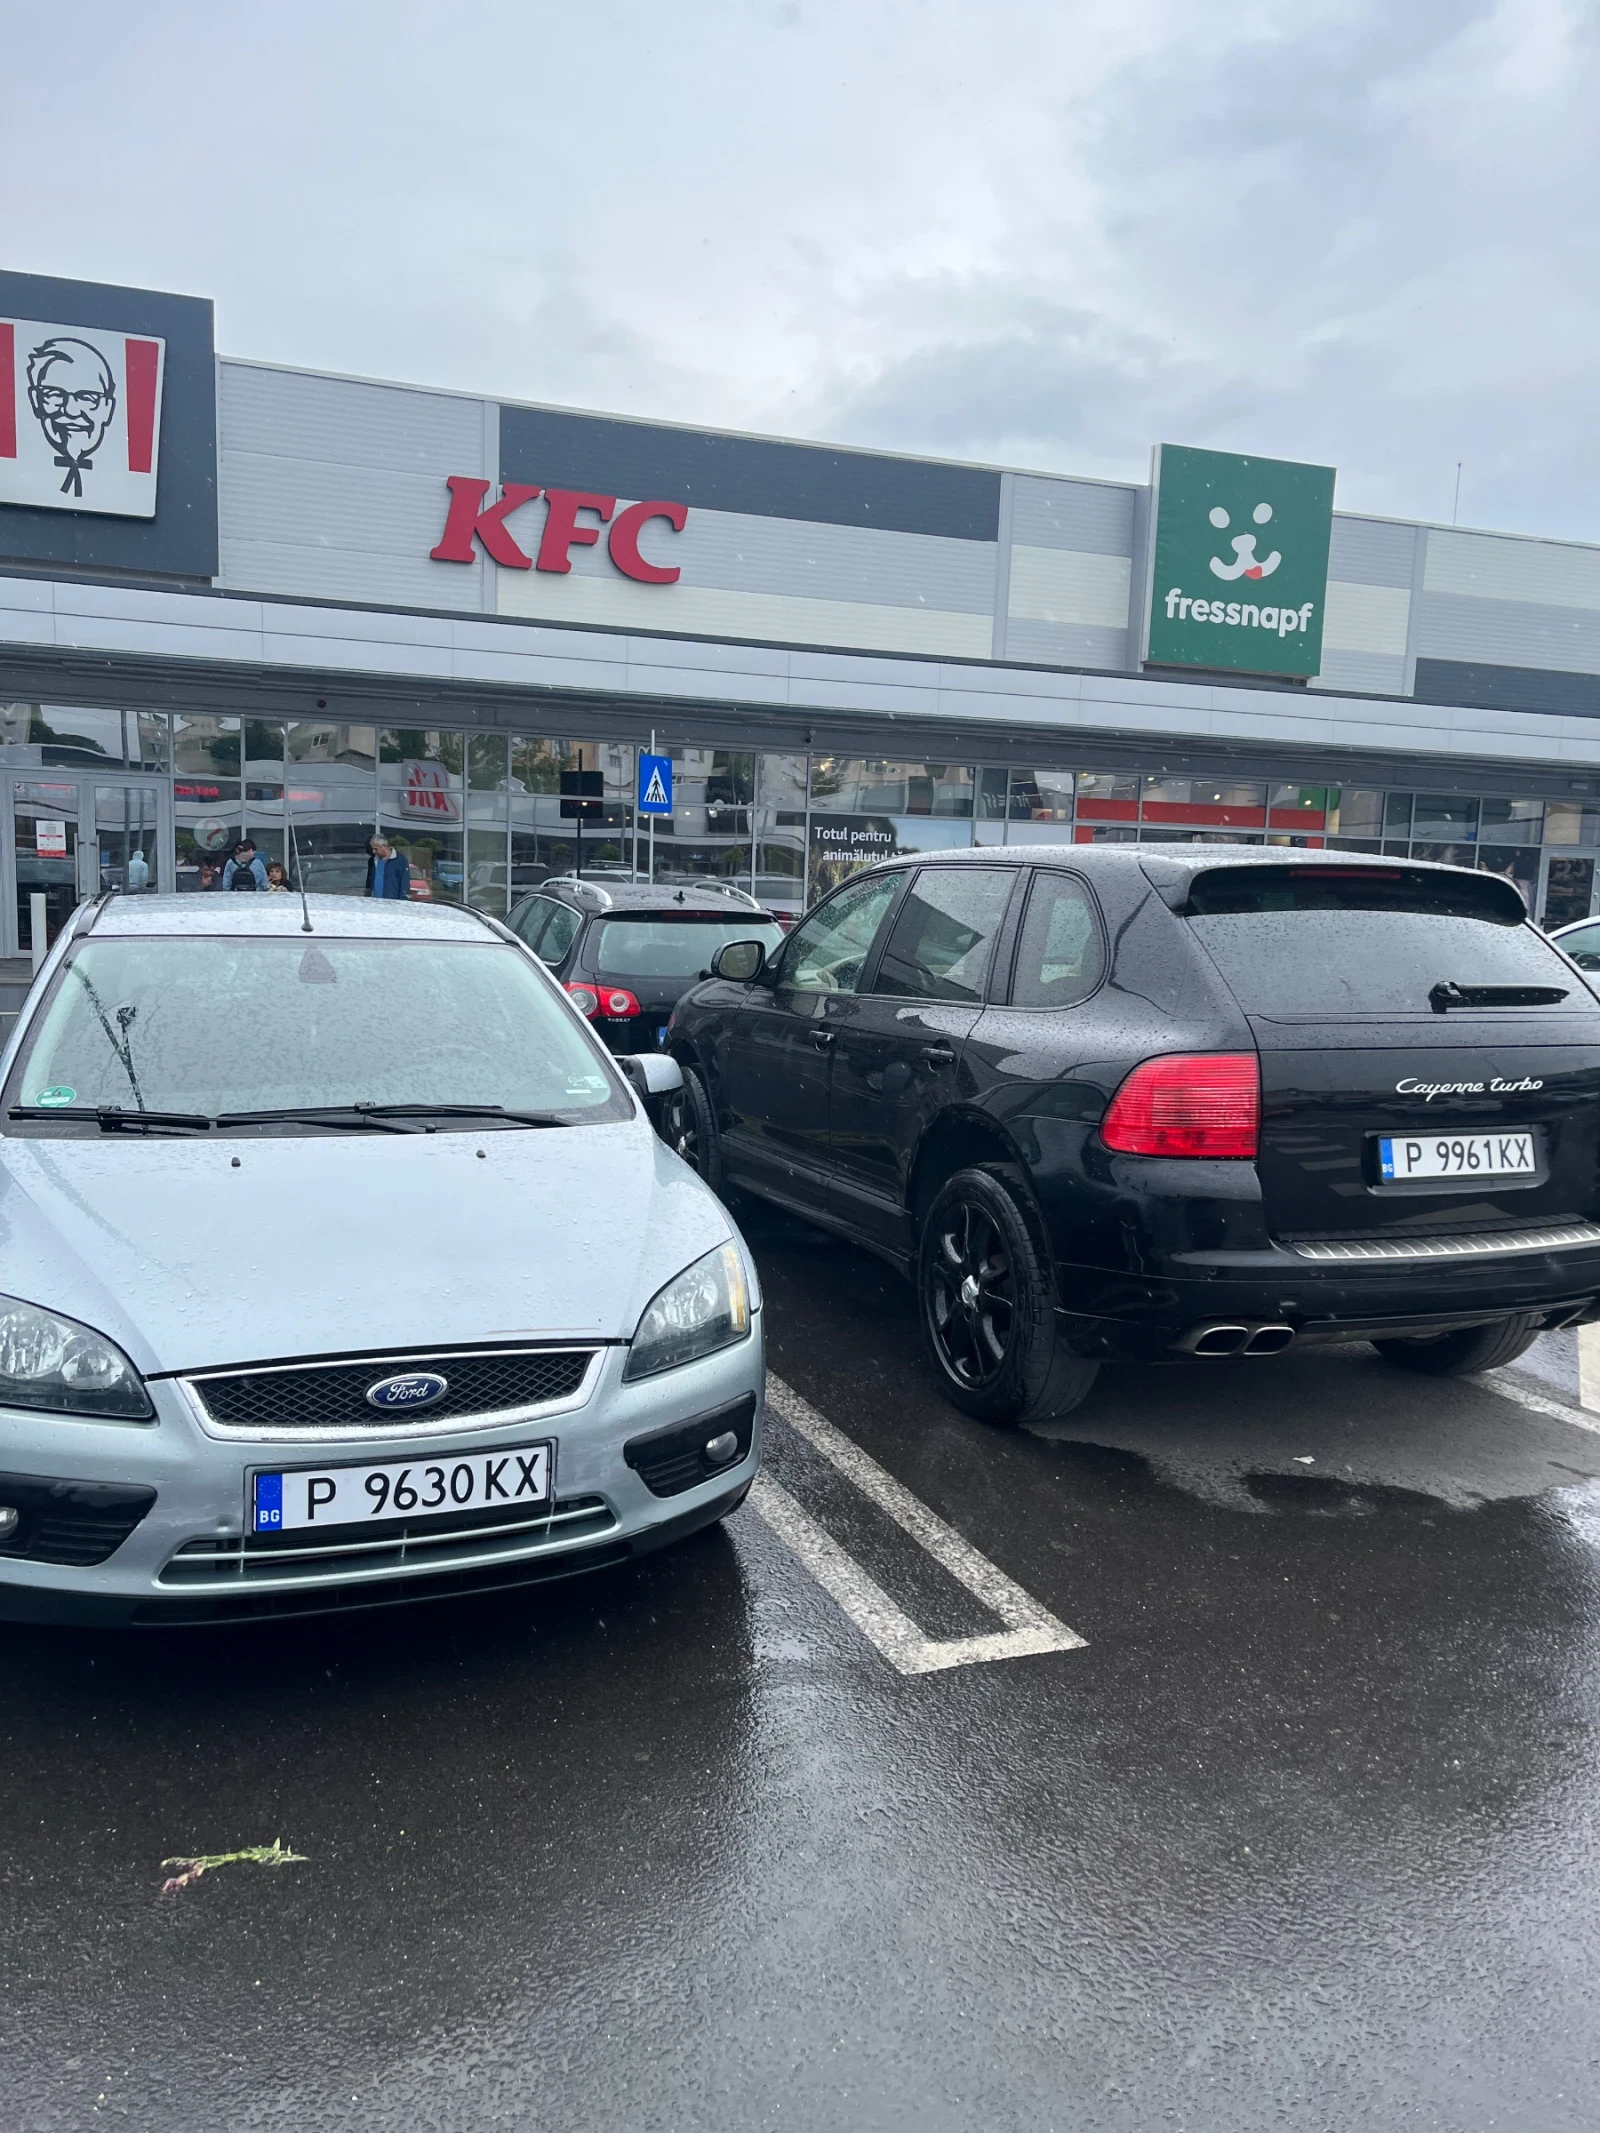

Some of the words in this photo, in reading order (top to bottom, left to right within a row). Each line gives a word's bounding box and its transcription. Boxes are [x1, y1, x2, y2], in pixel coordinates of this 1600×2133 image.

[430, 475, 688, 584] KFC
[1165, 587, 1314, 638] fressnapf
[814, 826, 848, 840] Totul
[851, 830, 892, 844] pentru
[1395, 1078, 1485, 1102] Cayenne
[1490, 1076, 1544, 1092] turbo
[1382, 1163, 1393, 1173] BG
[1406, 1142, 1422, 1173] P
[386, 1380, 429, 1401] Ford
[307, 1477, 336, 1520] P
[259, 1508, 281, 1524] BG
